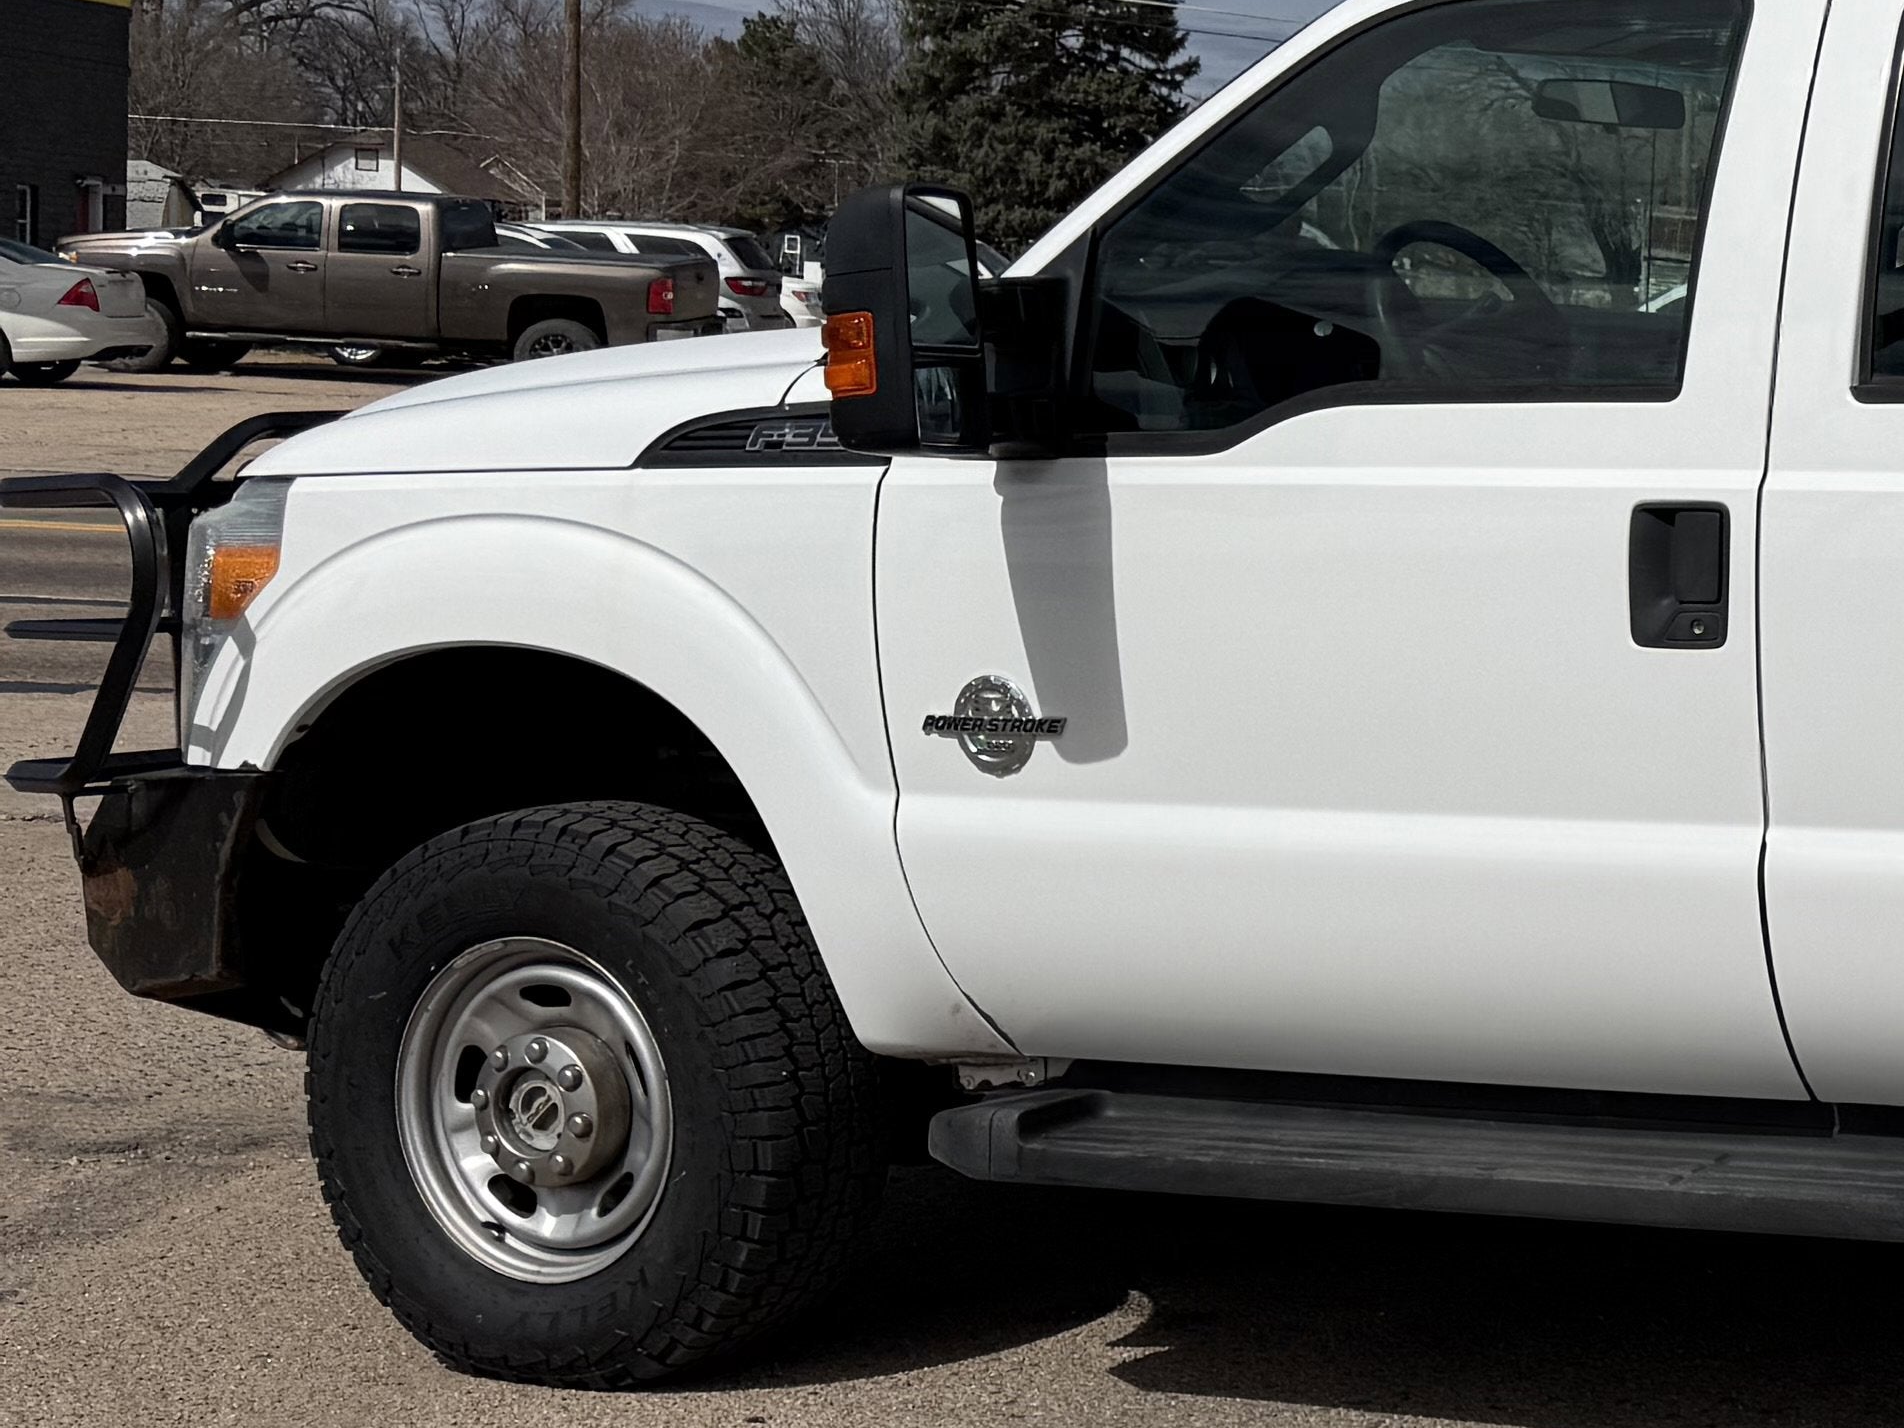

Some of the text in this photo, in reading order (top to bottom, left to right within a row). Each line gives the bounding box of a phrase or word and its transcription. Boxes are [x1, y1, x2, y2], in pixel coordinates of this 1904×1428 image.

[745, 422, 845, 451] F-35
[922, 715, 1063, 734] POWER STROKE
